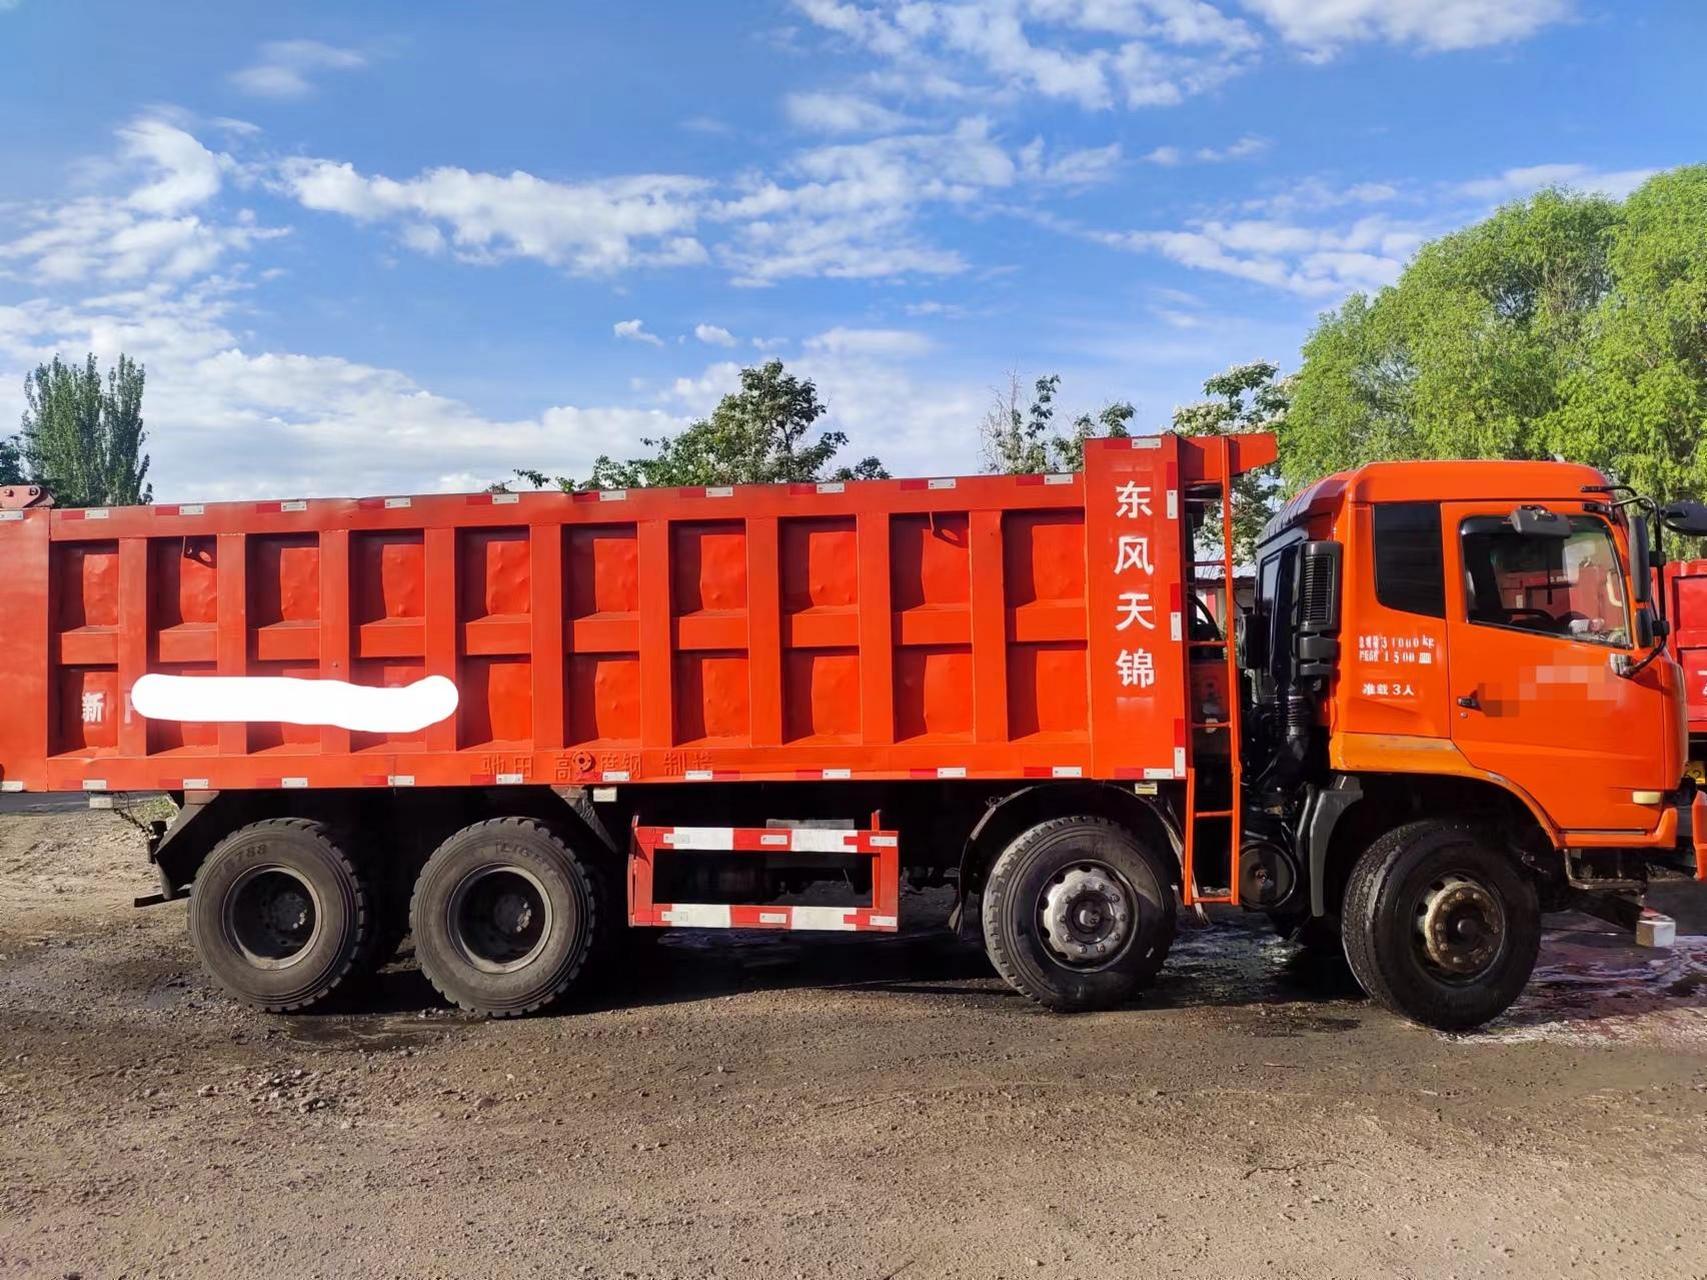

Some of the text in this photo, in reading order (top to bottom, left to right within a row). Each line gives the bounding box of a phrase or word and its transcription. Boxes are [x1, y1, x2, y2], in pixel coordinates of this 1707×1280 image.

[1114, 480, 1156, 689] 东风天锦
[82, 692, 104, 722] 新
[553, 752, 642, 781] 高度钢
